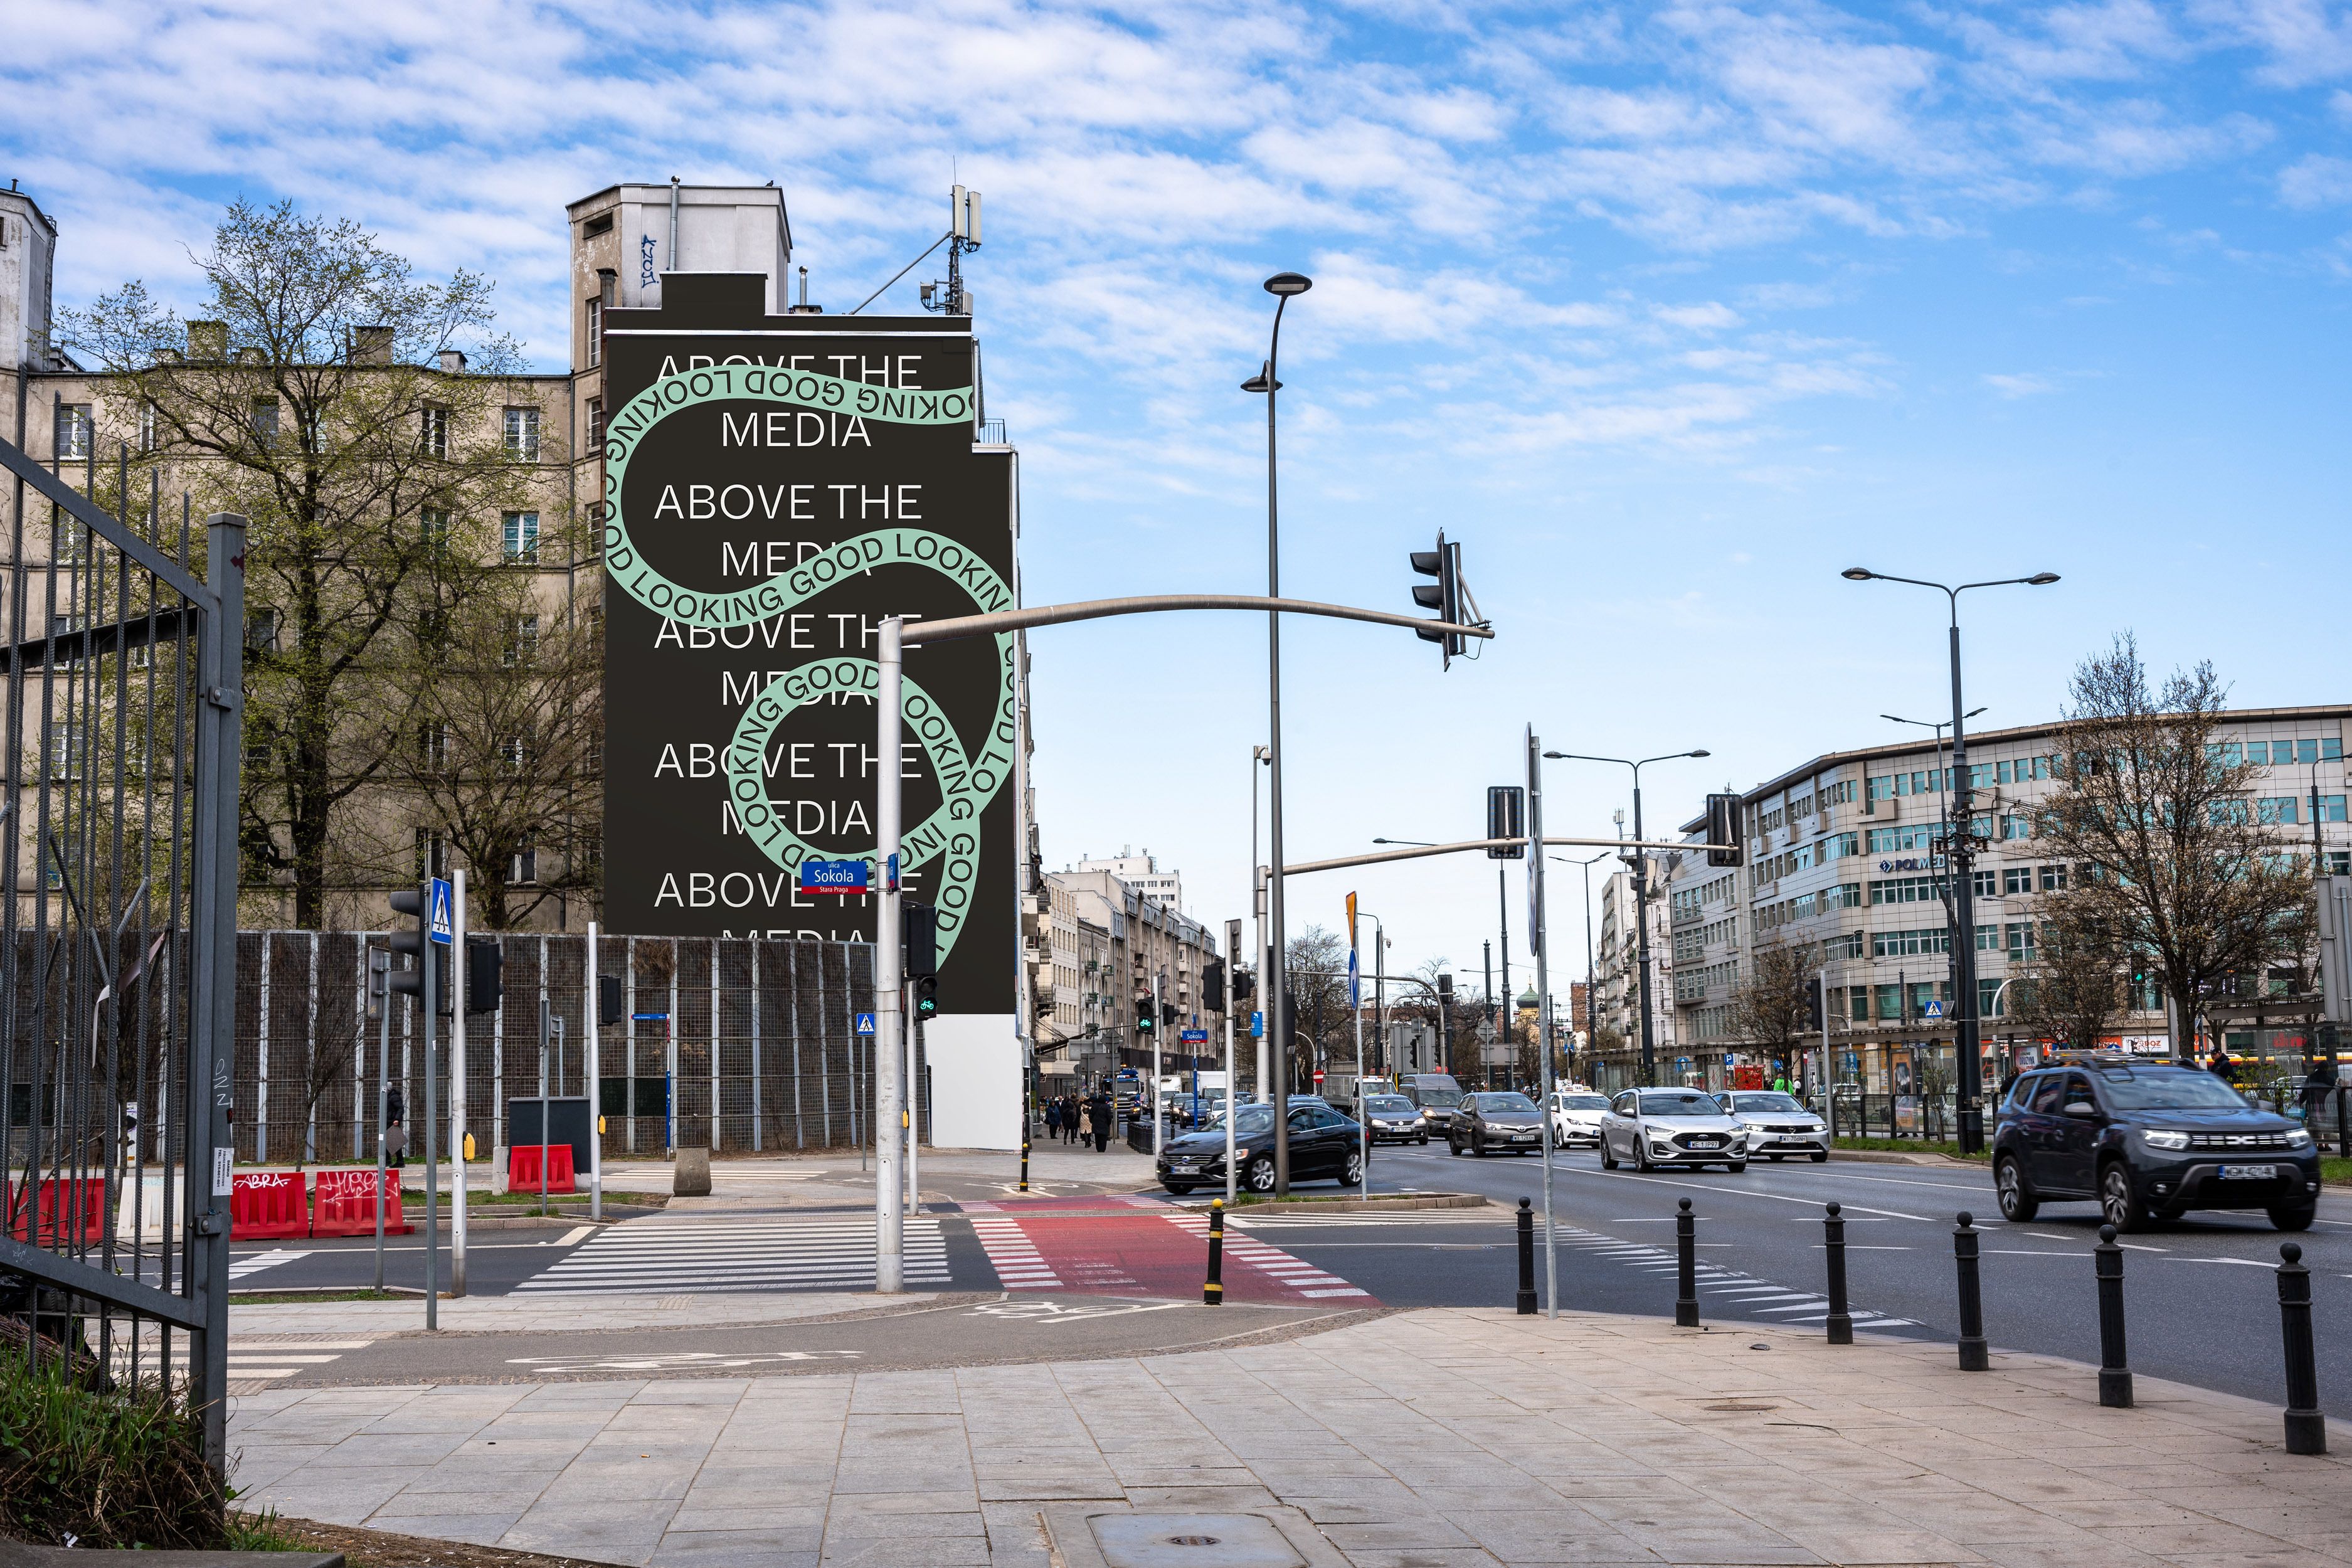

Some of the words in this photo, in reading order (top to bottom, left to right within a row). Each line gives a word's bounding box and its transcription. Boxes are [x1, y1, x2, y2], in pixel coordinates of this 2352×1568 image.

[745, 371, 845, 406] GOOD
[828, 355, 922, 390] THE
[607, 370, 731, 462] LOOKING
[857, 388, 974, 420] OKING
[723, 412, 871, 447] MEDIA
[654, 484, 815, 519] ABOVE
[828, 484, 922, 519] THE
[723, 542, 871, 576] MED
[790, 538, 883, 595] GOOD
[630, 570, 785, 623] LOOKING
[896, 533, 1012, 635] LOOKIN
[654, 614, 815, 649] ABOVE
[784, 662, 878, 699] GOOD
[654, 743, 815, 778] ABVE
[901, 680, 974, 821] OOKING
[733, 697, 783, 847] LOOKING
[814, 869, 854, 882] Sokola
[1895, 855, 1946, 871] POLMED
[654, 872, 815, 908] ABOVE
[935, 833, 975, 932] GOOD
